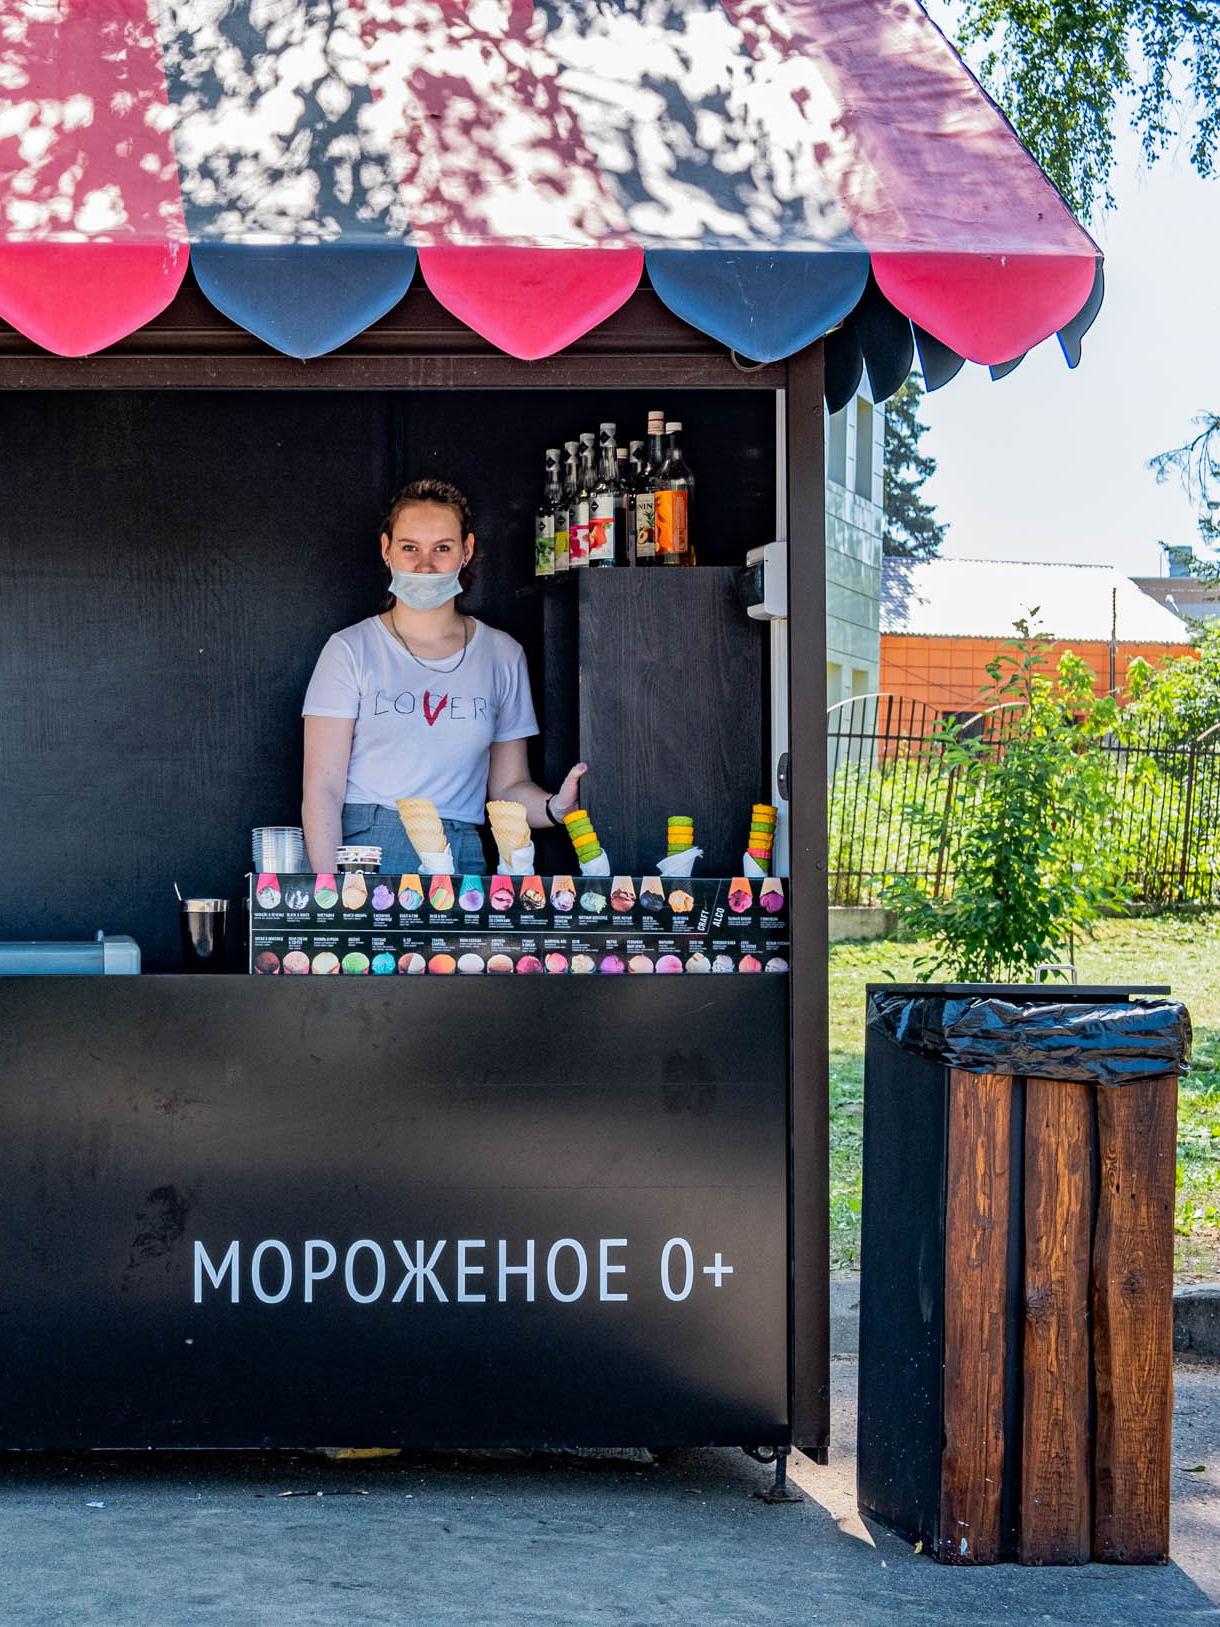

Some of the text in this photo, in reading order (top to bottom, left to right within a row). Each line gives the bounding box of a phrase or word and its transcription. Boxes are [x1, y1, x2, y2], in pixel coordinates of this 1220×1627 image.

[374, 690, 488, 726] LOVER
[697, 909, 709, 931] CRAFT
[712, 907, 725, 927] ALCO
[193, 1237, 734, 1304] МОРОЖЕНОЕ 0+
